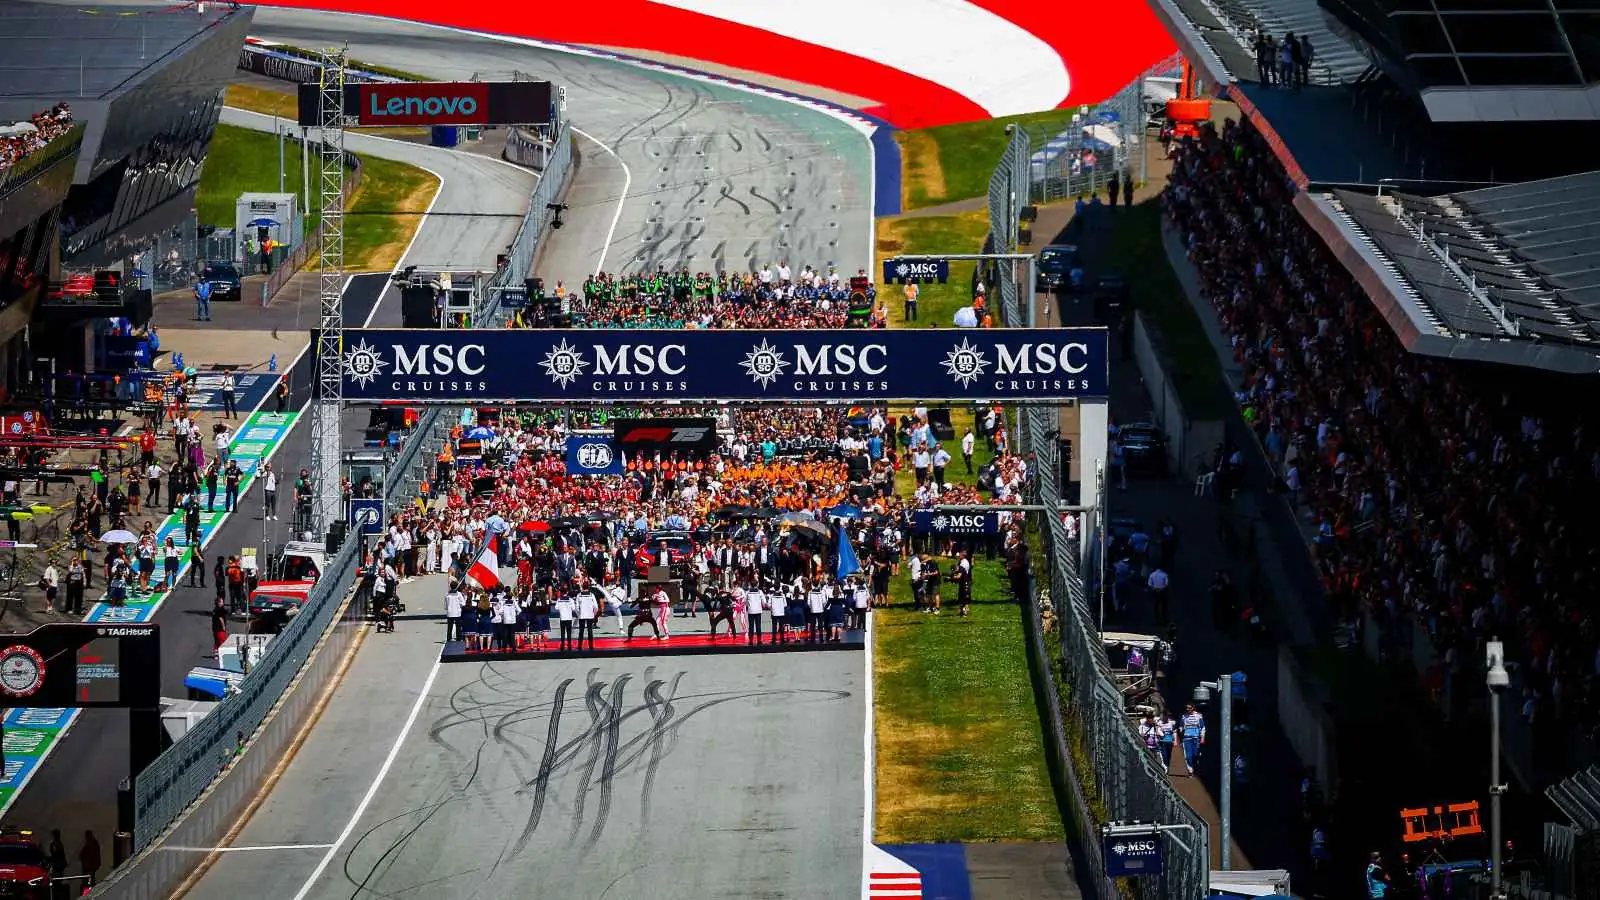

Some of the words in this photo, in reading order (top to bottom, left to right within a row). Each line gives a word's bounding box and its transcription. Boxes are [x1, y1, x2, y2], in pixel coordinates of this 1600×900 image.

[371, 93, 477, 115] Lenovo
[910, 263, 938, 274] MSC
[392, 344, 485, 375] MSC
[592, 344, 686, 375] MSC
[793, 344, 887, 375] MSC
[994, 343, 1088, 374] MSC
[392, 381, 486, 391] CRUISES
[592, 381, 687, 390] CRUISES
[793, 381, 888, 390] CRUISES
[994, 380, 1089, 390] CRUISES
[579, 448, 610, 464] FIA
[950, 515, 984, 527] MSC
[1128, 841, 1155, 851] MSC
